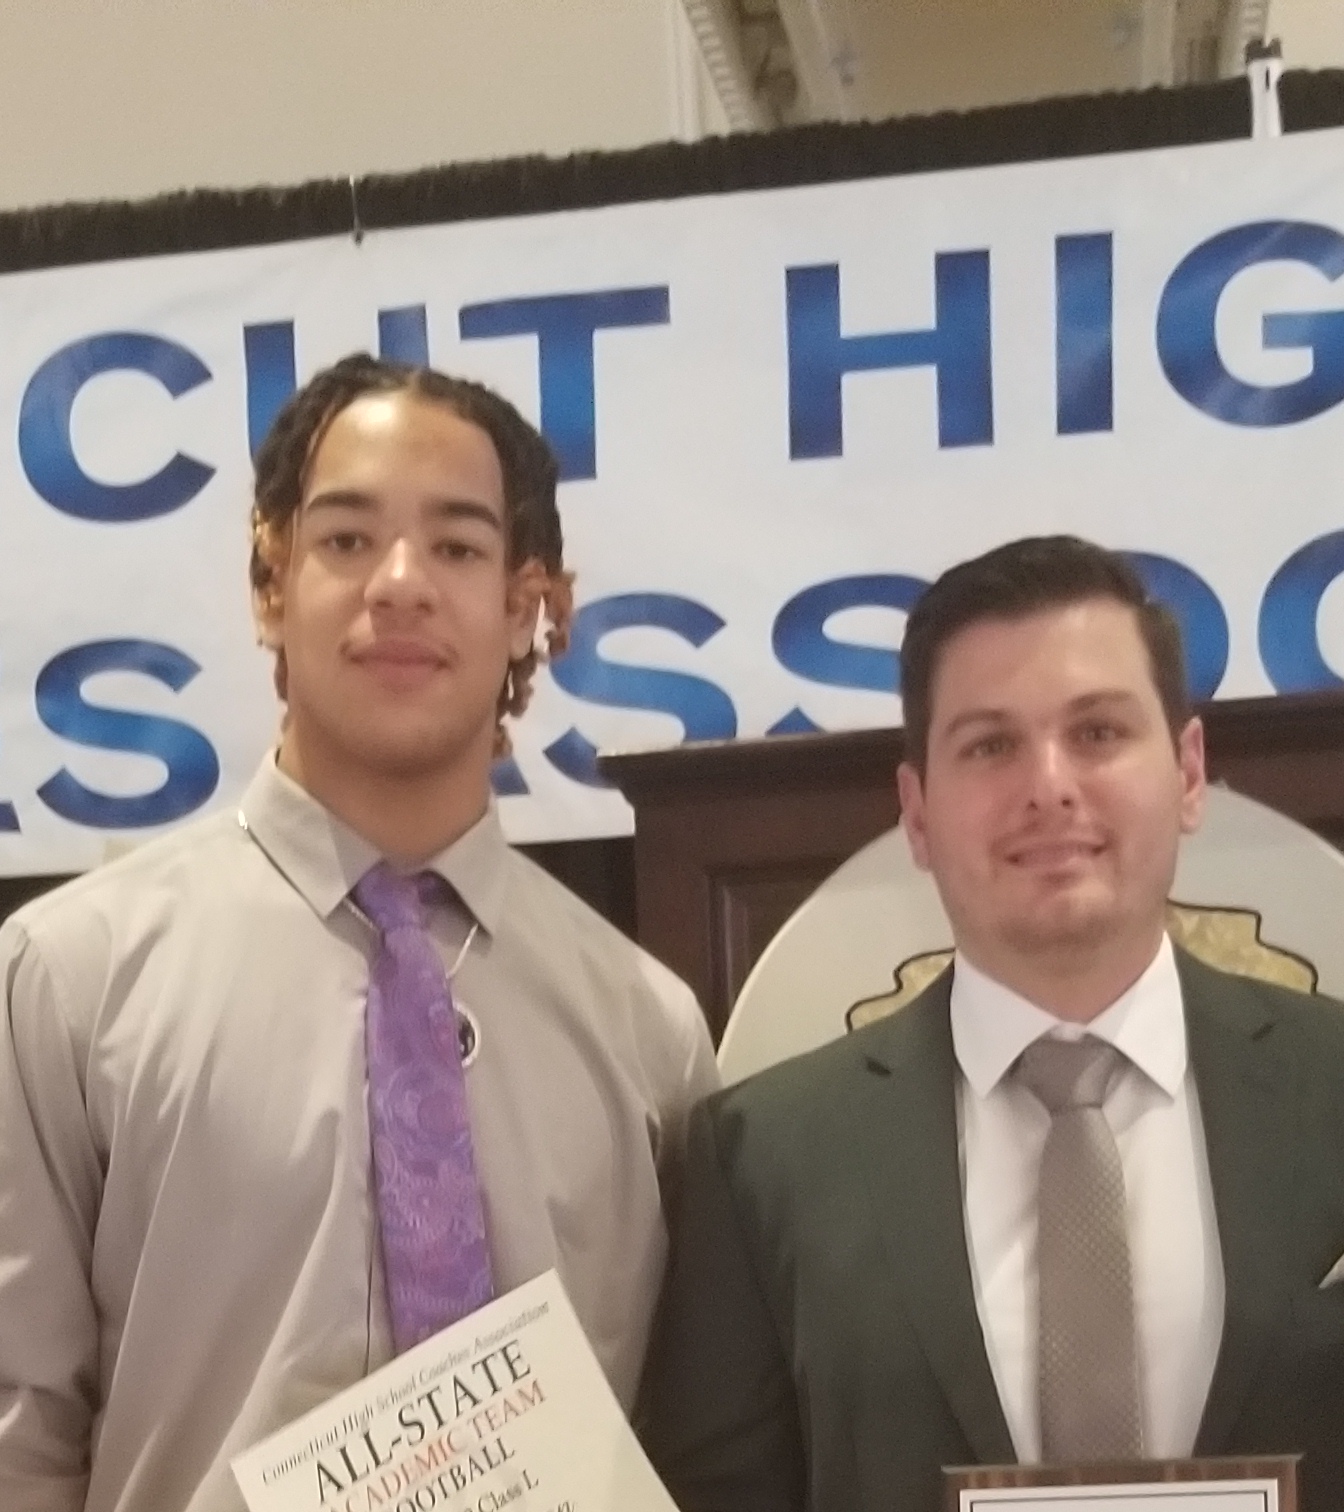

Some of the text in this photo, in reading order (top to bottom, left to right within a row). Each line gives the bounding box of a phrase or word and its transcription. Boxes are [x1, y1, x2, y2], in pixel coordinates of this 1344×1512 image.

[262, 1426, 338, 1485] Connecticut
[342, 1405, 374, 1434] High
[377, 1376, 416, 1409] School
[314, 1339, 531, 1505] ALL-STATE
[468, 1378, 546, 1439] TEAM
[522, 1468, 539, 1491] L
